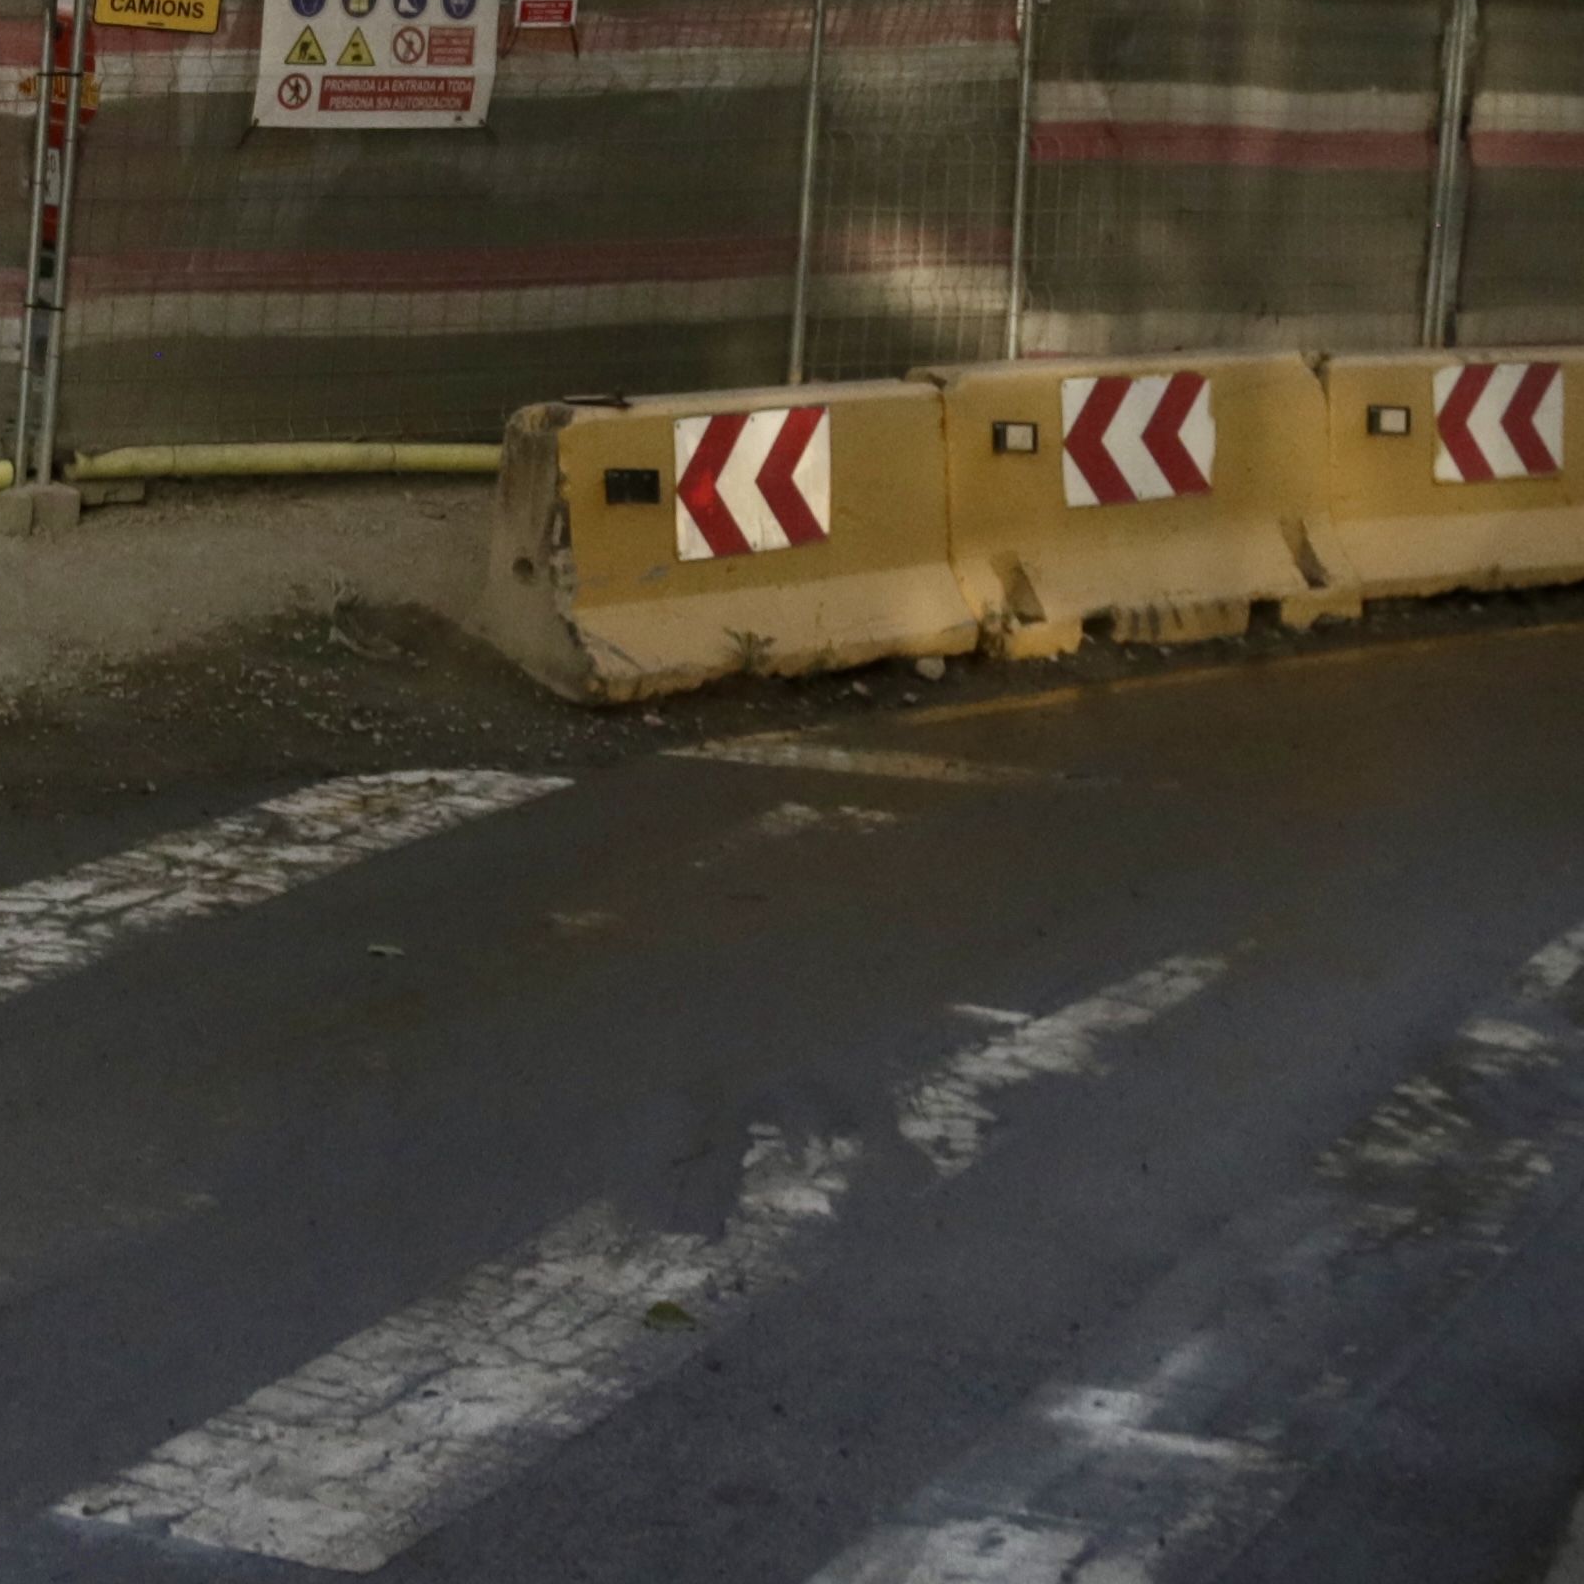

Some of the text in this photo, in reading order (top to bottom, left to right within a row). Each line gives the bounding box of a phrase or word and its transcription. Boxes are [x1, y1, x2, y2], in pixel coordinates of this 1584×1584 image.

[324, 79, 473, 93] PROHIBIDA LA ENTRADA A TODA
[329, 96, 375, 109] PERSONA
[376, 96, 391, 109] SIN
